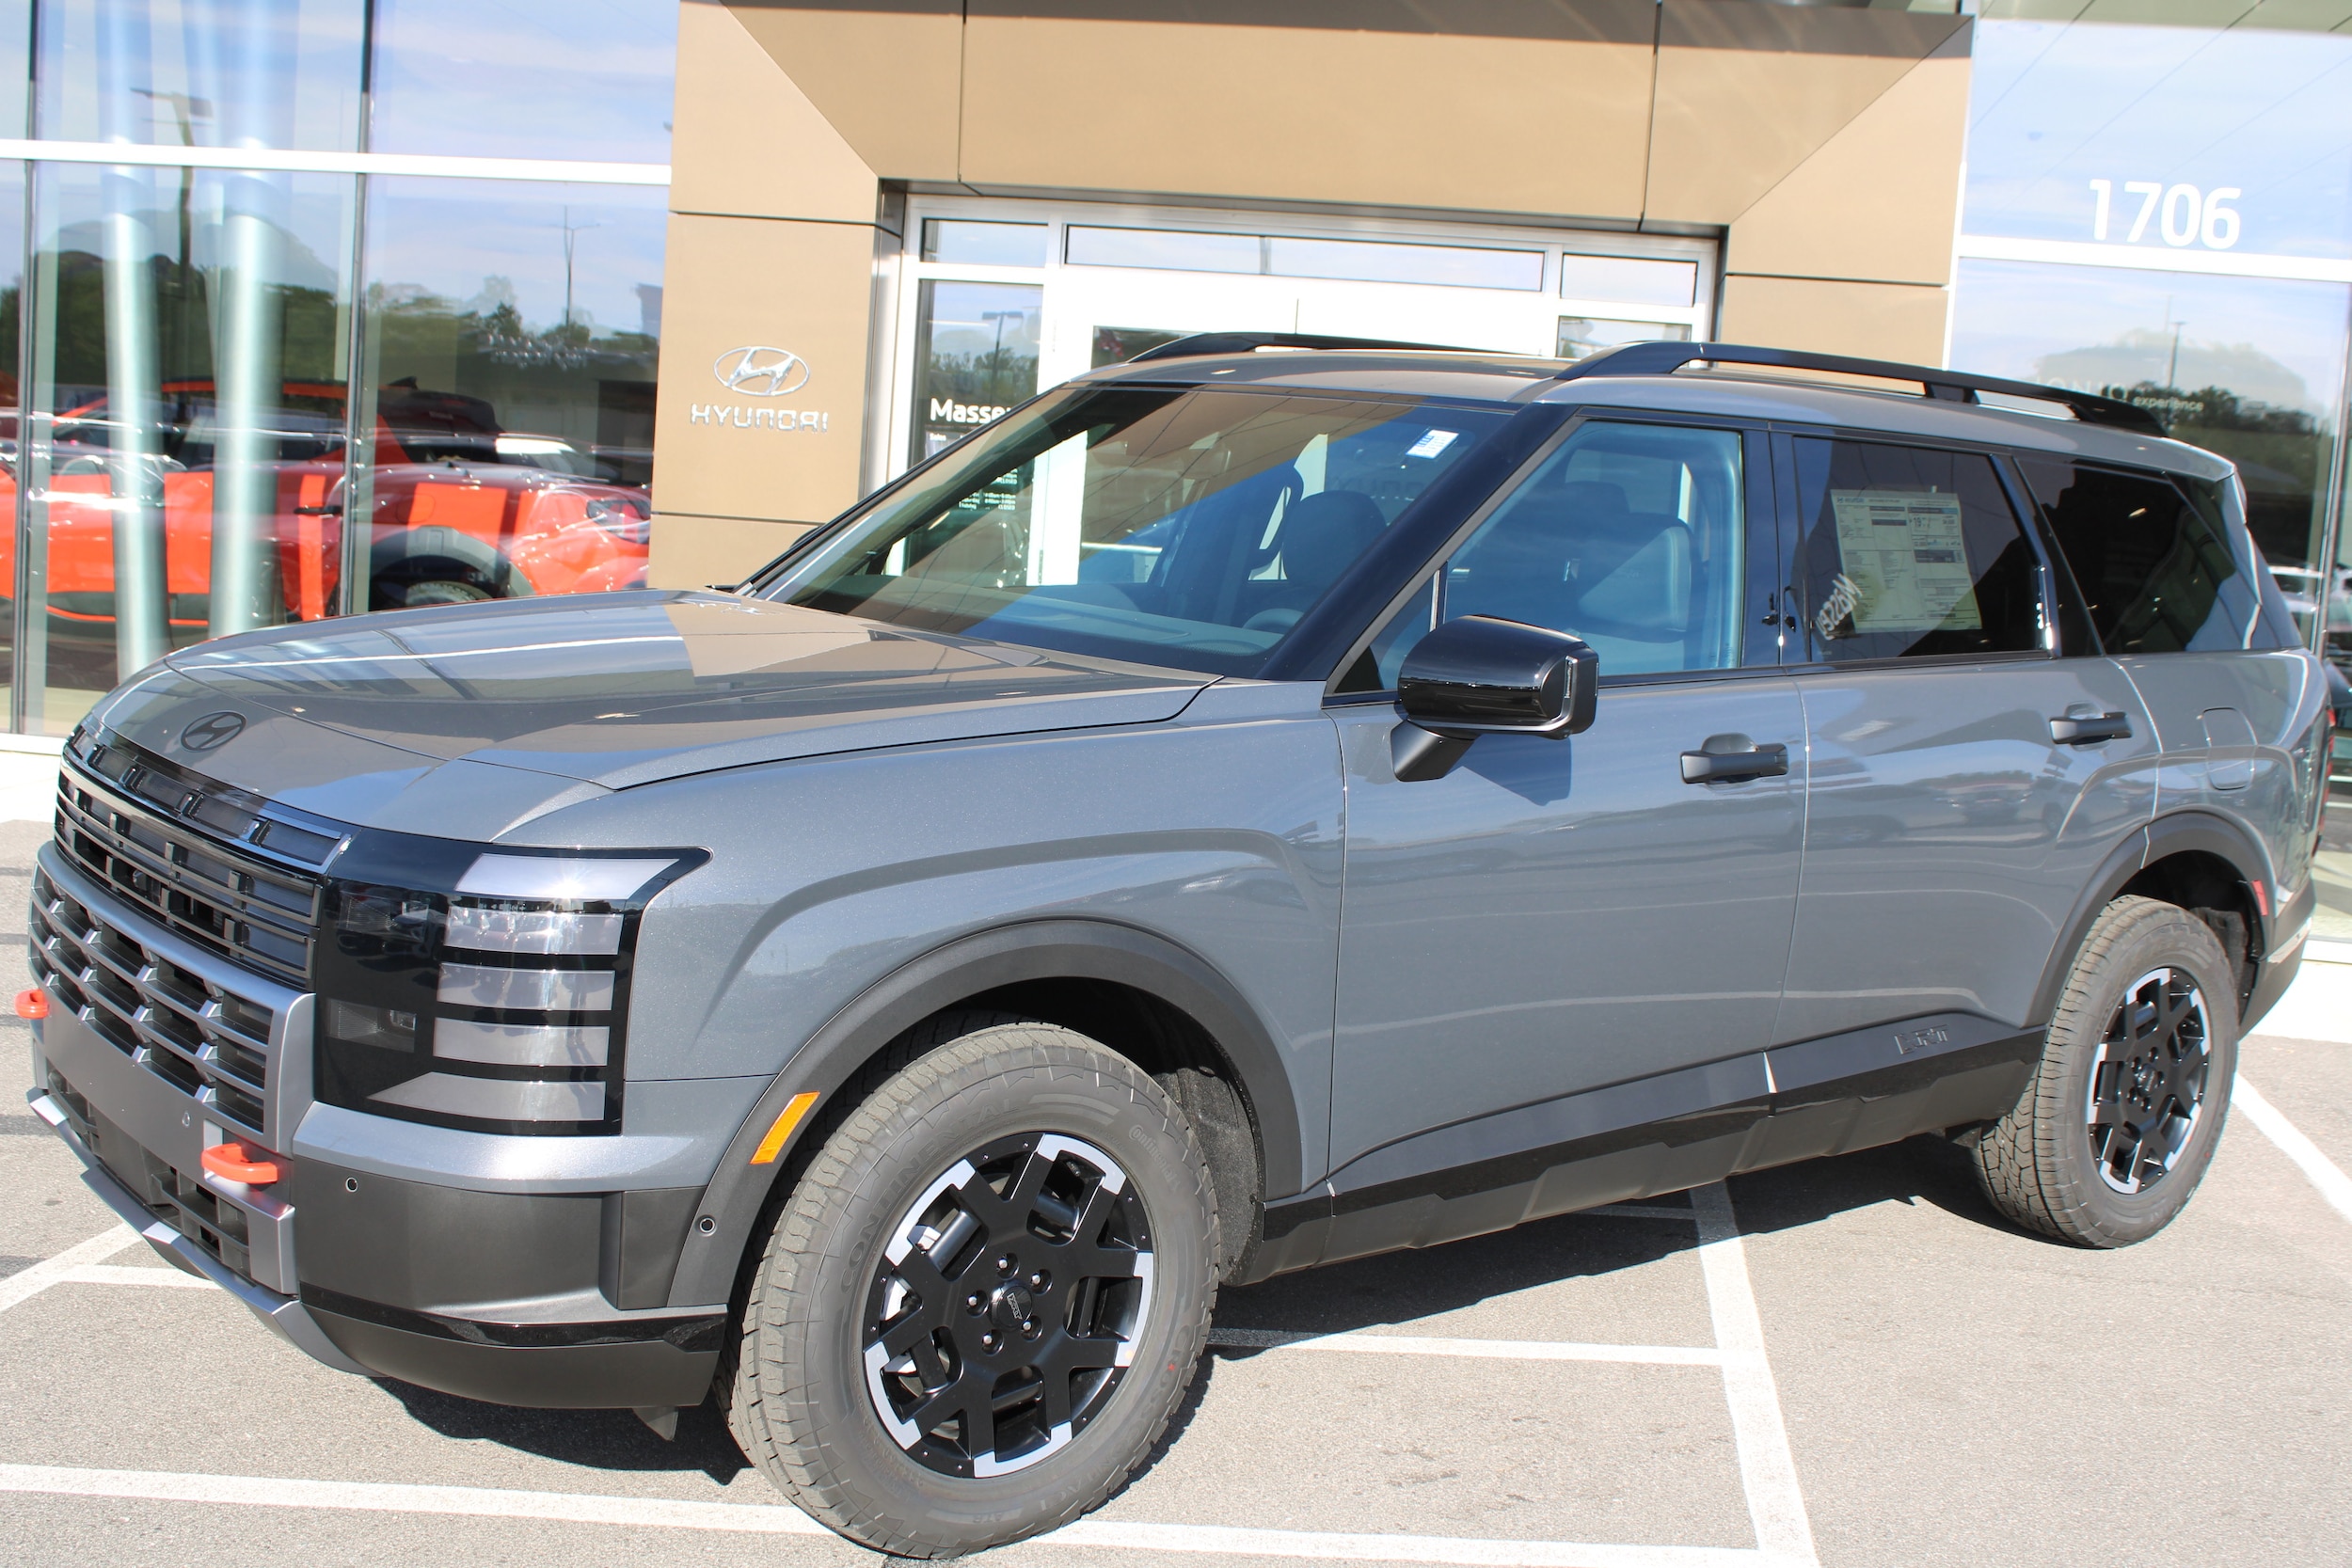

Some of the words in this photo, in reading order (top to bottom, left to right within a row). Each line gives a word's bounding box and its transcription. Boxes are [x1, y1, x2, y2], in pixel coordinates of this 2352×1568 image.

[2089, 178, 2241, 250] 1706
[691, 403, 829, 434] HYUNDAI
[930, 397, 1012, 424] Masse
[2133, 395, 2204, 412] experience
[1129, 1124, 1178, 1183] Continental
